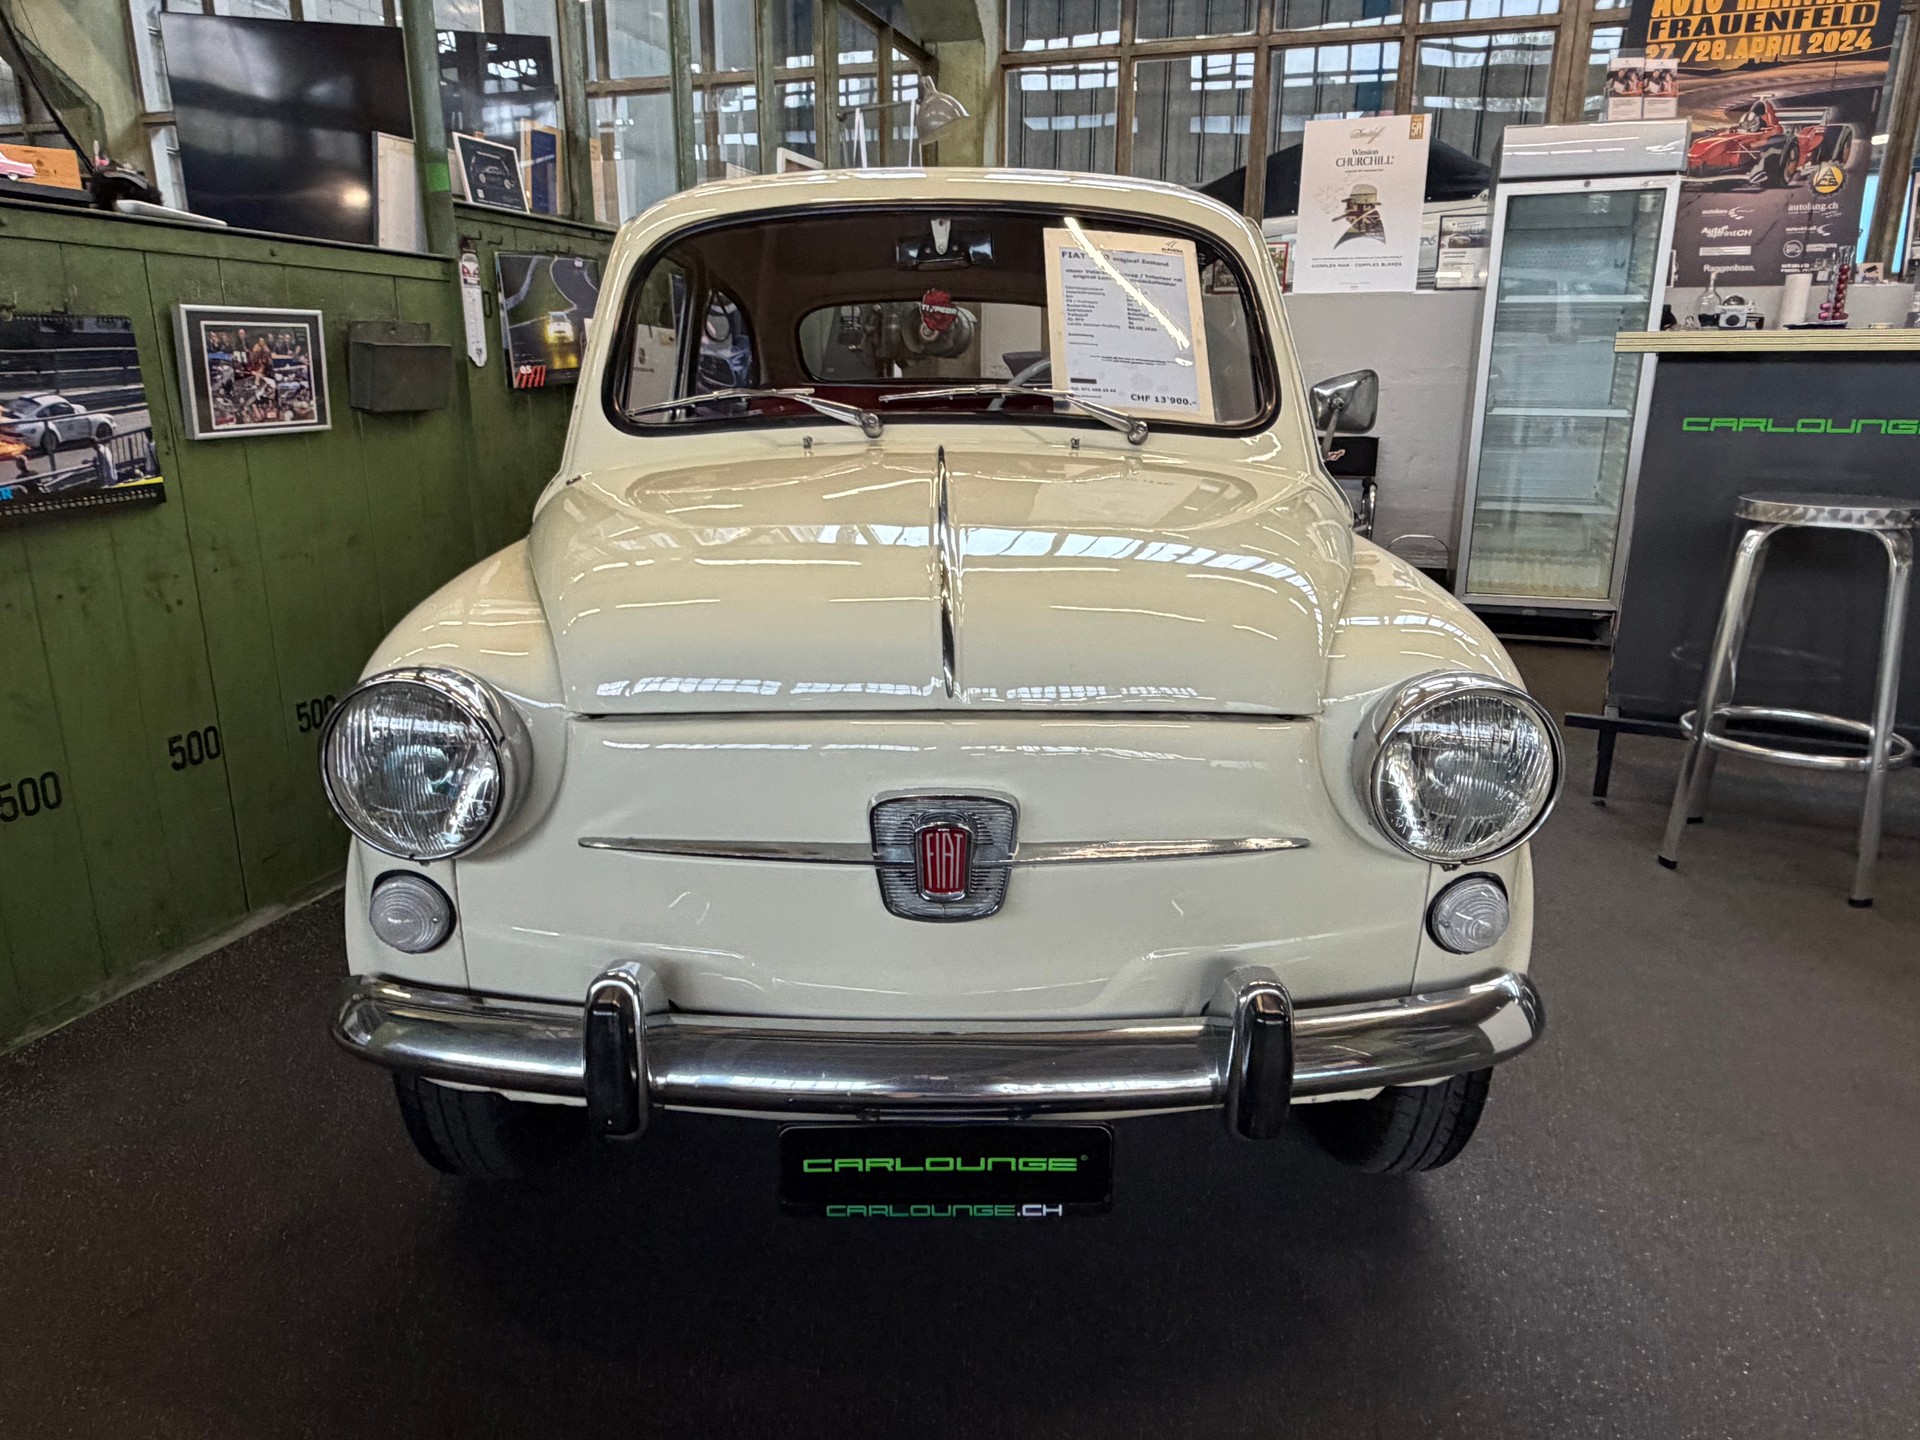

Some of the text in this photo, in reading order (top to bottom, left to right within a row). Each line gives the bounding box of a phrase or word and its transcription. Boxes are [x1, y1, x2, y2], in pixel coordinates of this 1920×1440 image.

[1649, 4, 1876, 40] FRAUENFELD
[1807, 28, 1873, 54] 2024
[1061, 251, 1086, 259] FIAT
[1130, 393, 1151, 402] CHF
[1682, 417, 1920, 435] CARLOUNG
[167, 725, 222, 771] 500
[0, 771, 63, 823] 500
[925, 831, 964, 889] FIAT
[802, 1157, 1078, 1173] CARLOUNGE
[826, 1203, 1063, 1218] CARLOUNGE.CH
